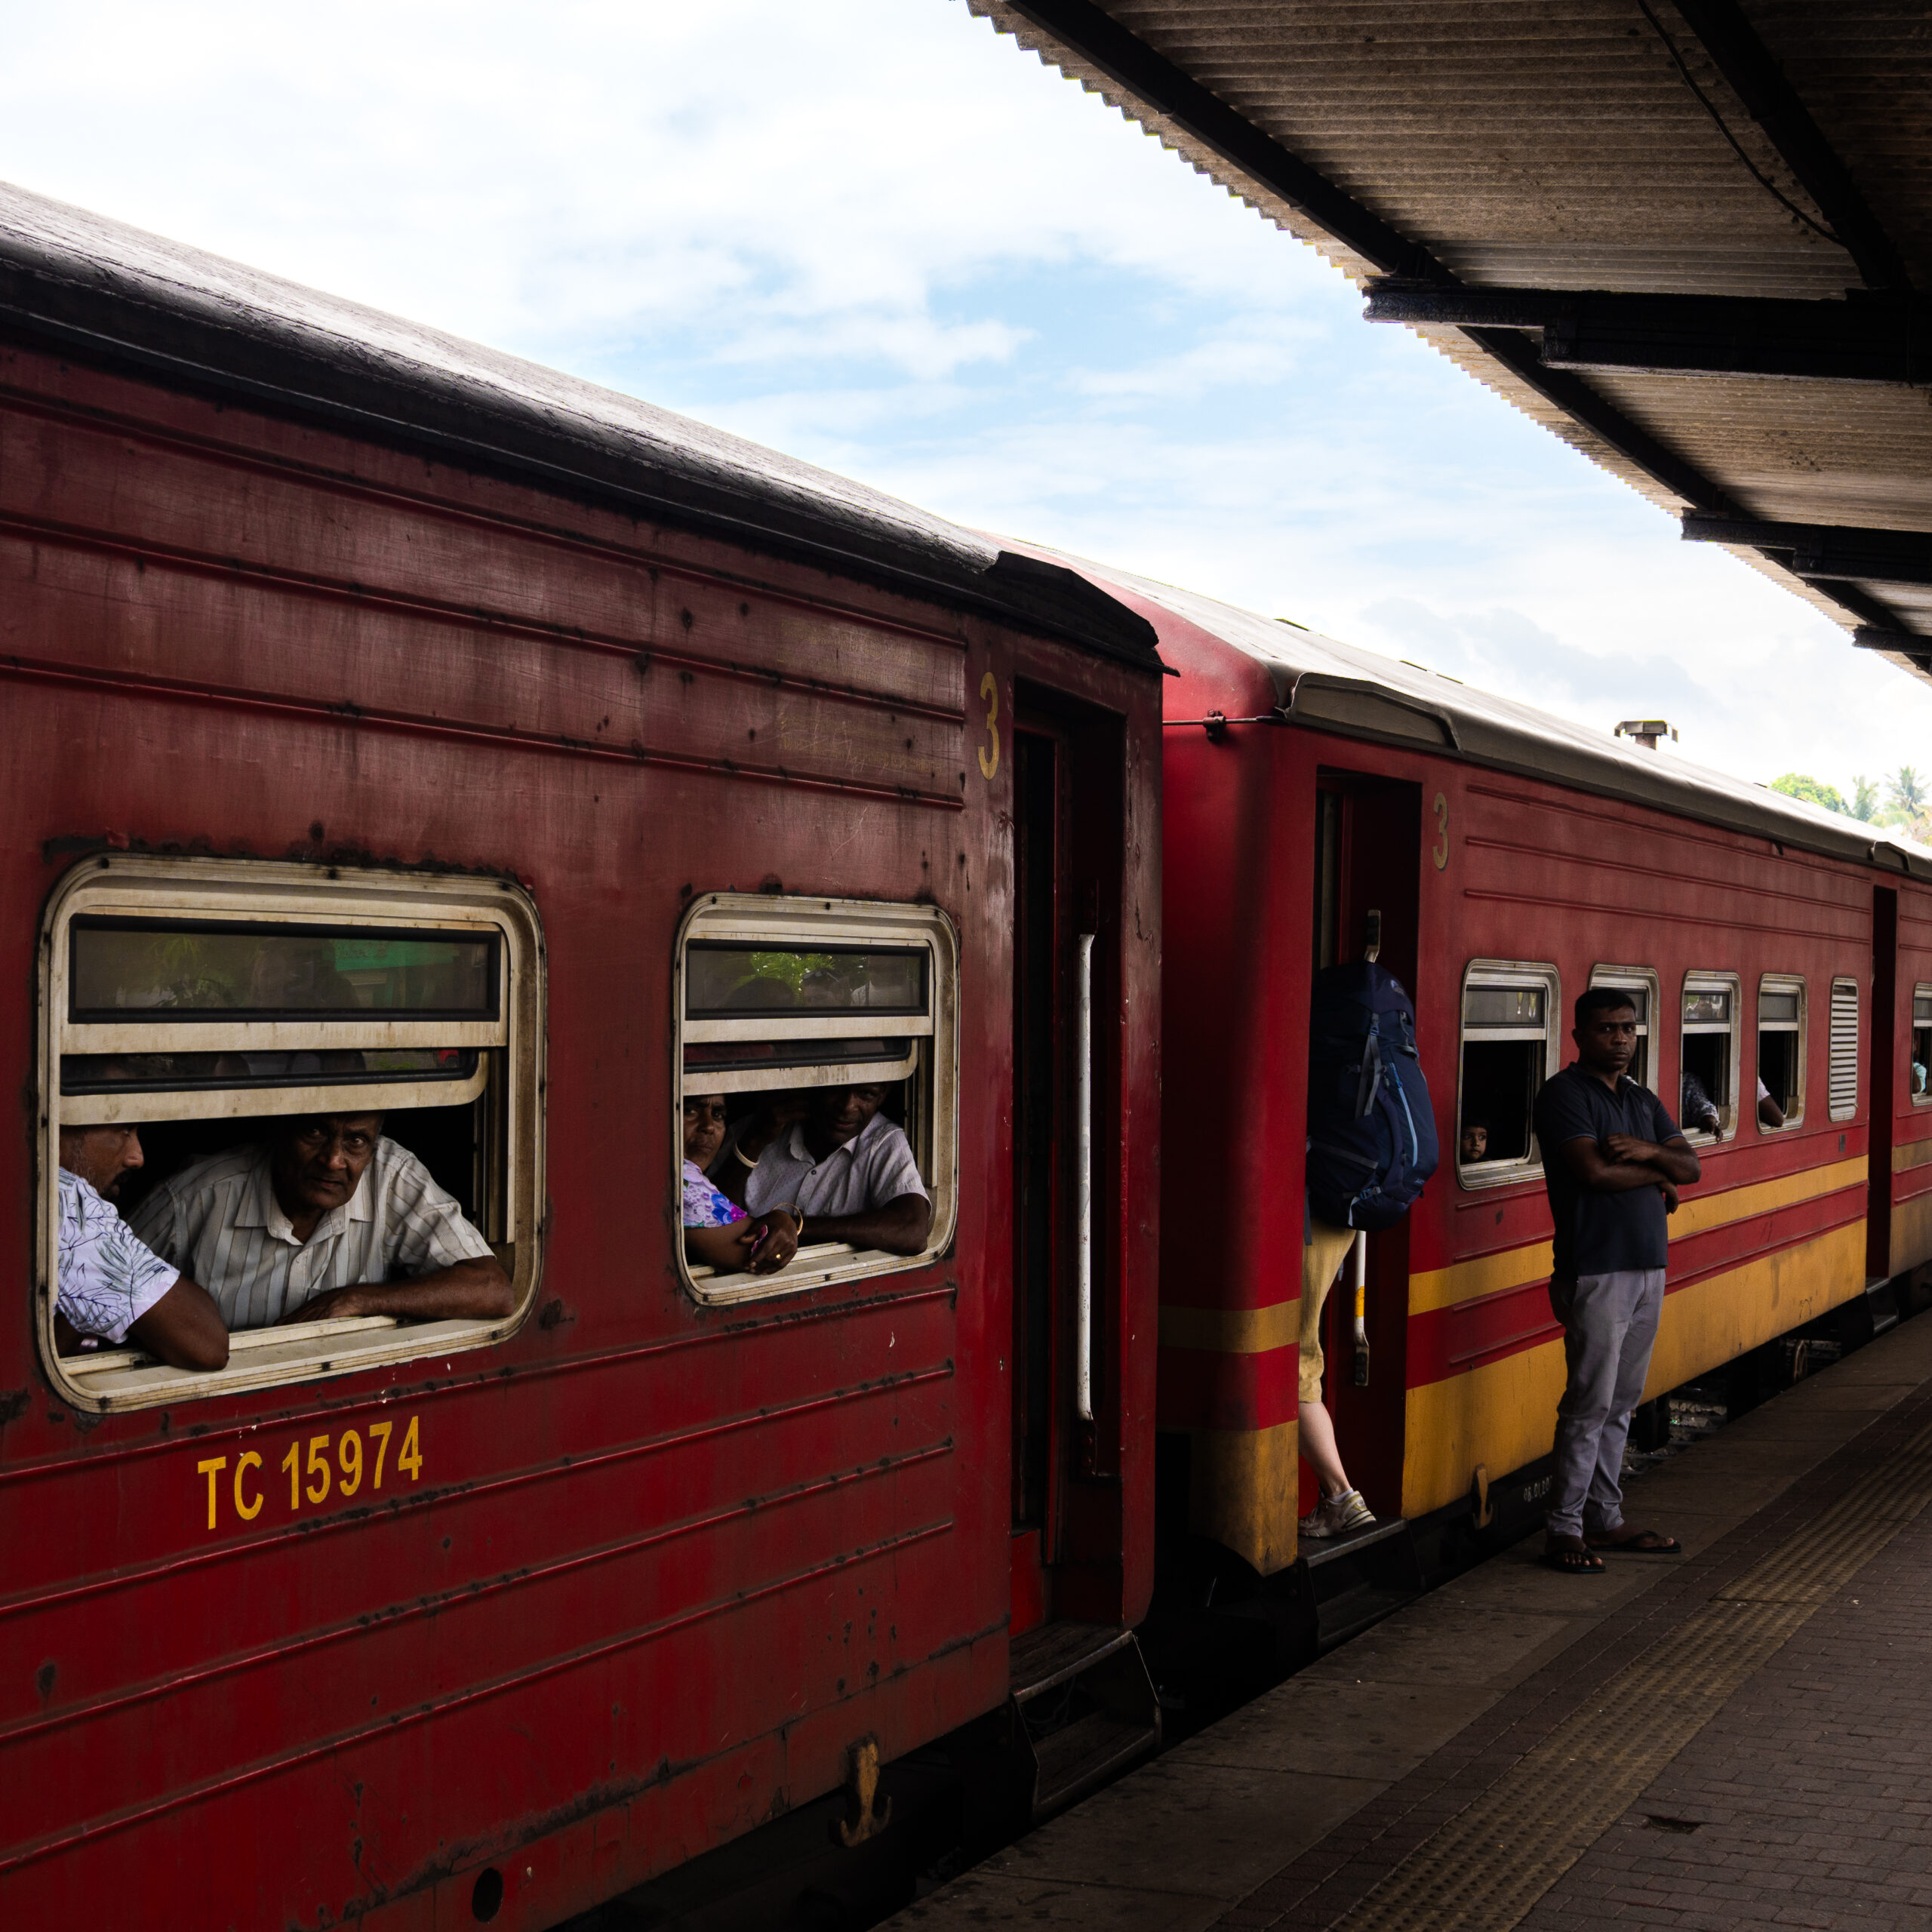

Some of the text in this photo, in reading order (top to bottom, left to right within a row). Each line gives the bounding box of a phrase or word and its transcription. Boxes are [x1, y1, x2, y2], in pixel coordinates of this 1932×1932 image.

[978, 672, 1000, 780] 3
[1433, 792, 1449, 871] 3
[198, 1416, 423, 1530] TC 15974
